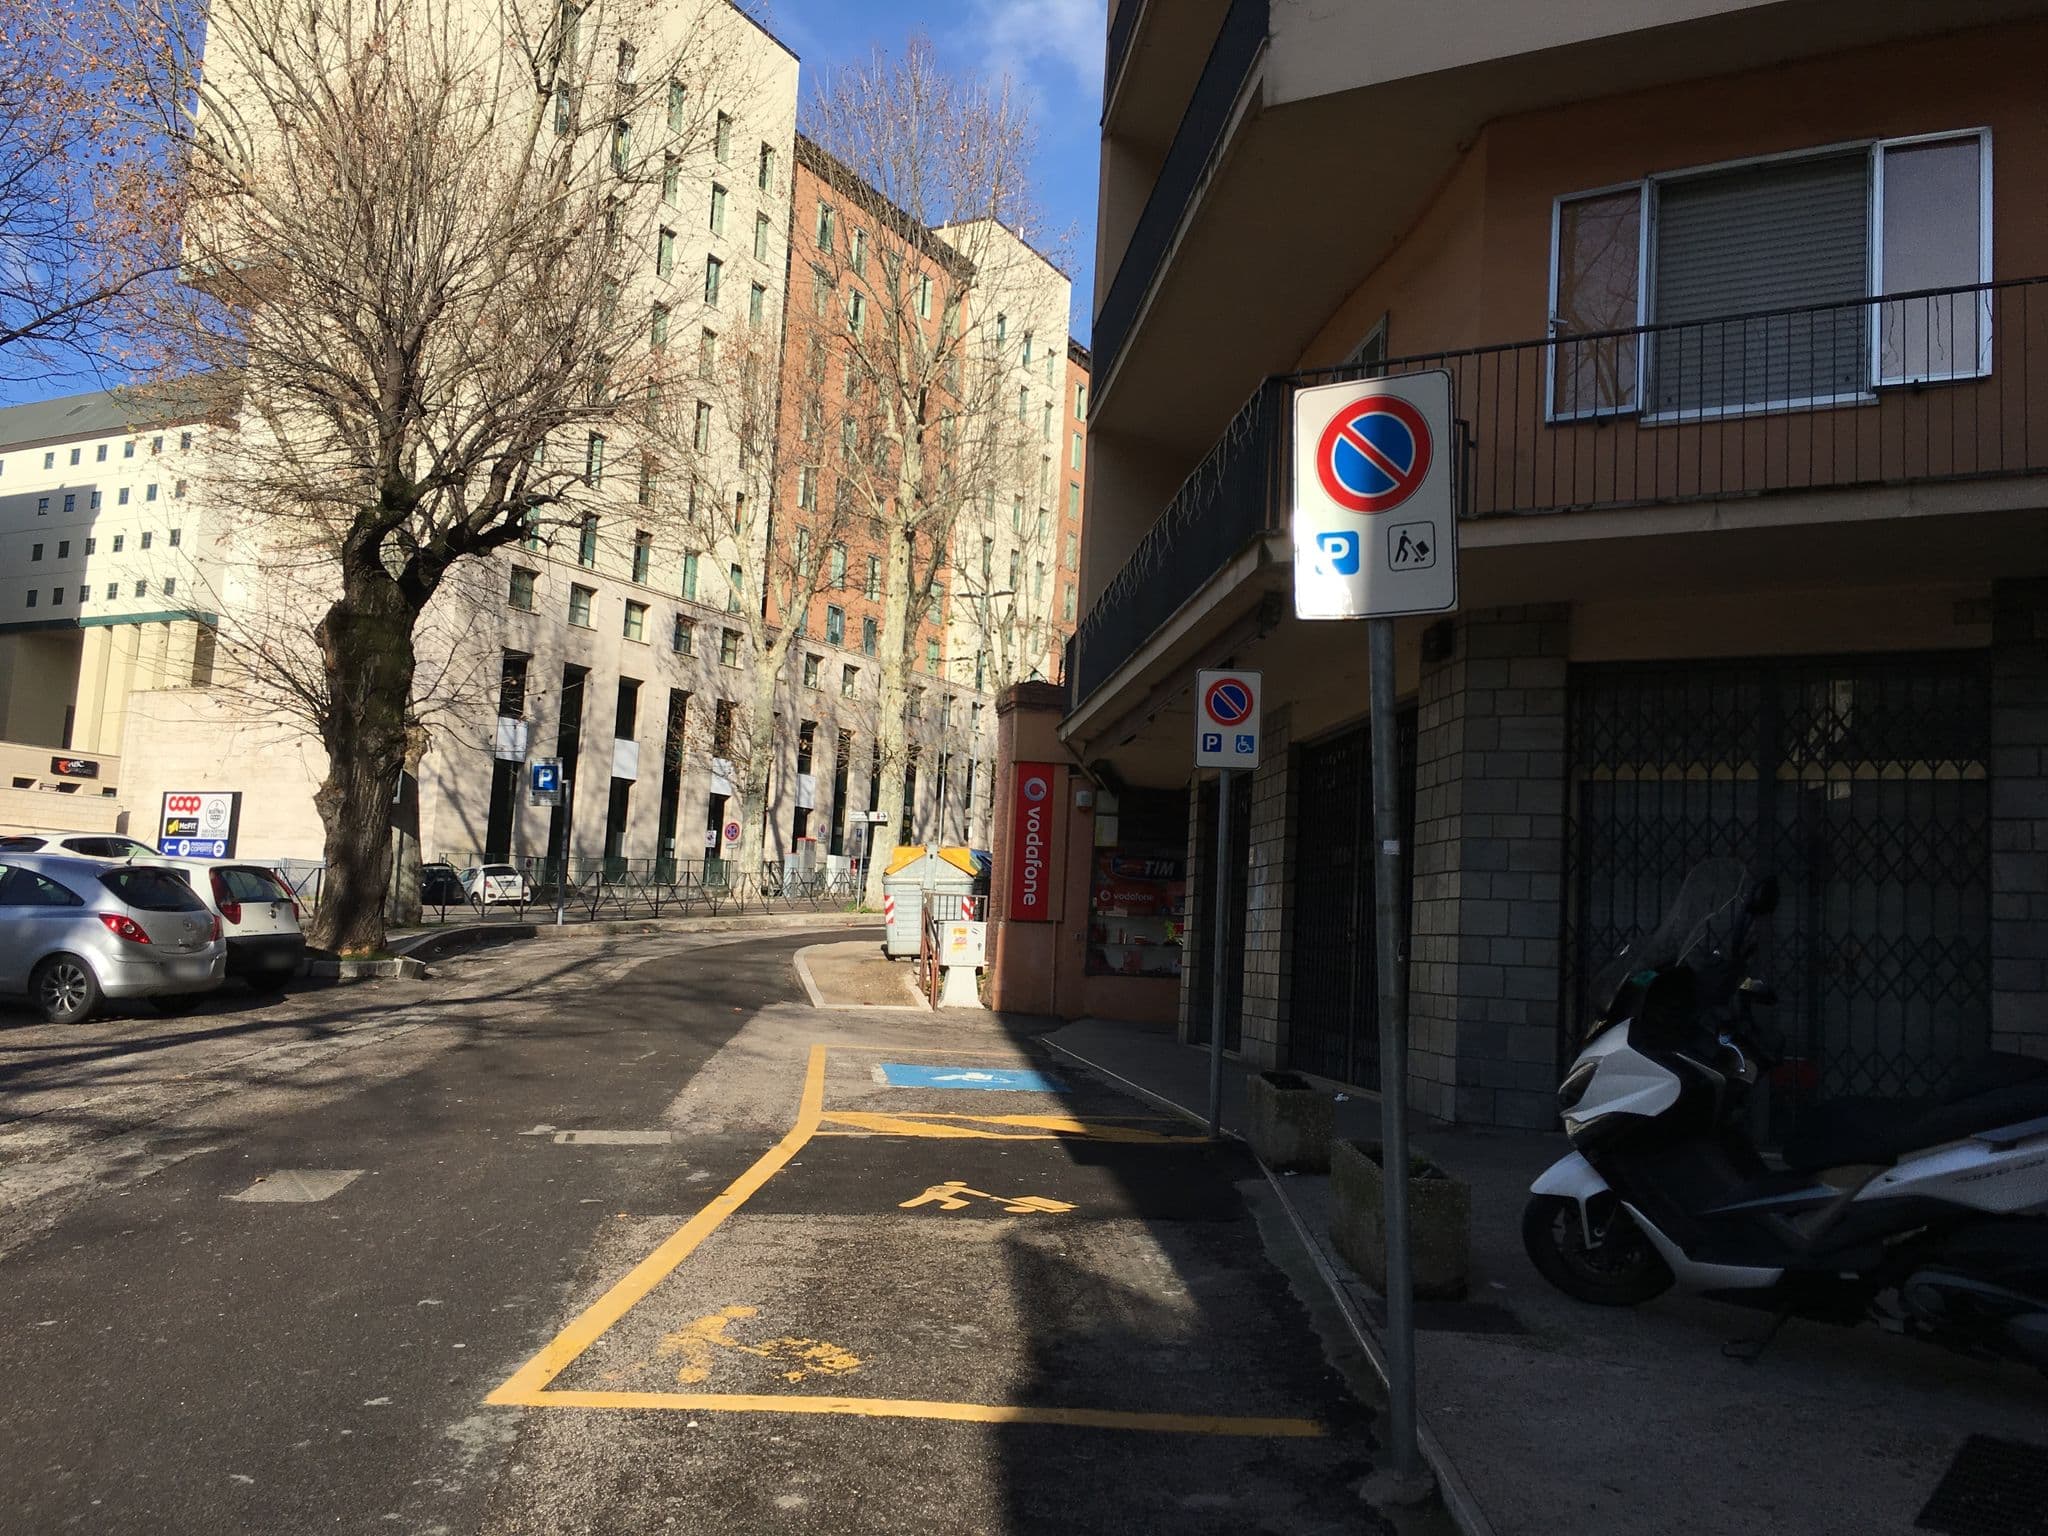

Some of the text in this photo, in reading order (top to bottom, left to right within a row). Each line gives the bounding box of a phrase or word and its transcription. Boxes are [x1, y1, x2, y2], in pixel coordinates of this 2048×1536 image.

[1324, 537, 1350, 571] P
[1206, 735, 1218, 750] P
[538, 769, 553, 787] P
[169, 796, 201, 815] coop
[1023, 806, 1043, 906] vodafone
[1144, 860, 1176, 877] TIM
[1113, 891, 1154, 902] vodafone
